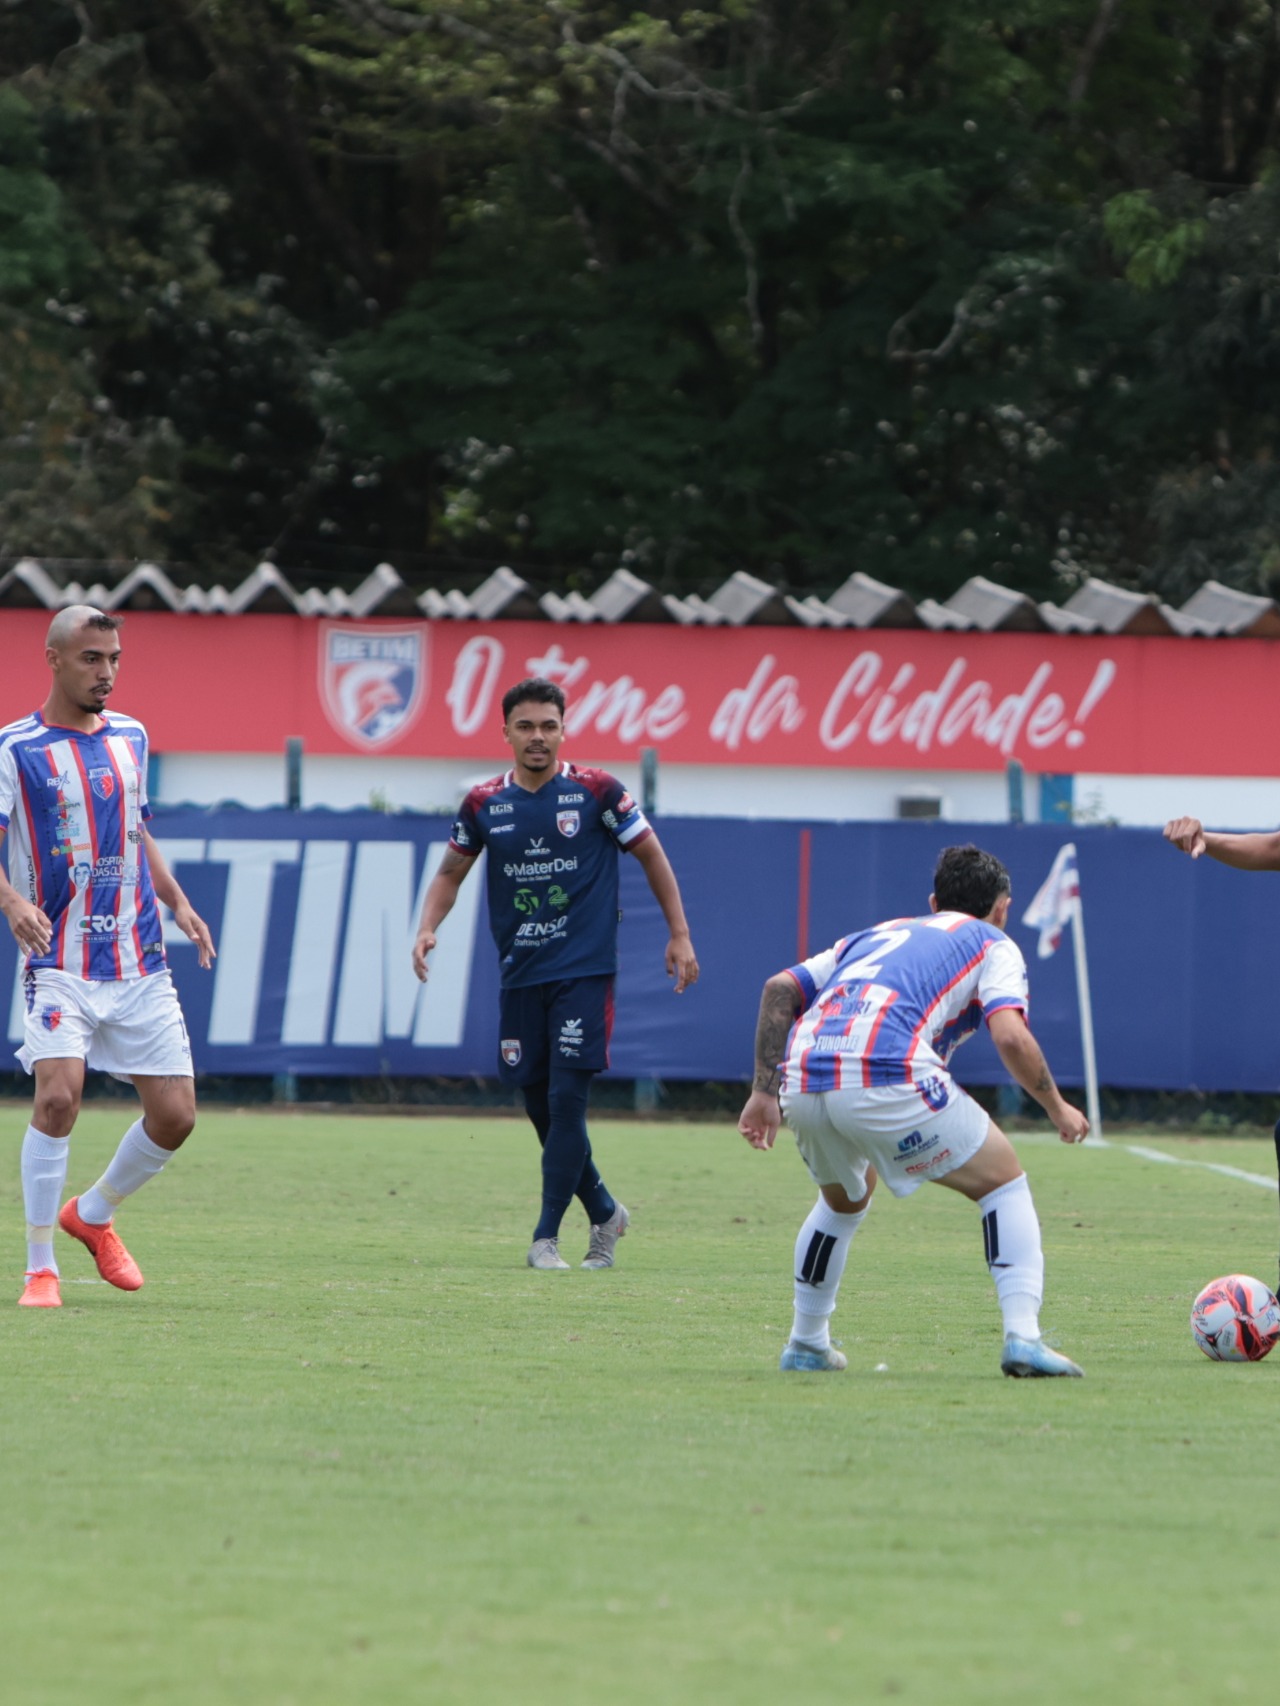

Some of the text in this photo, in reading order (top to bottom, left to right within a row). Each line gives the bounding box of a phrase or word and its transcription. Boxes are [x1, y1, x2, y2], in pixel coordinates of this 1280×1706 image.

[333, 636, 415, 659] BETIM
[447, 635, 504, 737] O
[707, 652, 804, 752] da
[558, 794, 584, 804] EGIS
[489, 804, 514, 814] EGIS
[91, 867, 111, 877] DAS
[516, 915, 568, 936] DENSO
[838, 928, 911, 982] 2
[815, 1035, 859, 1051] FUNORTE
